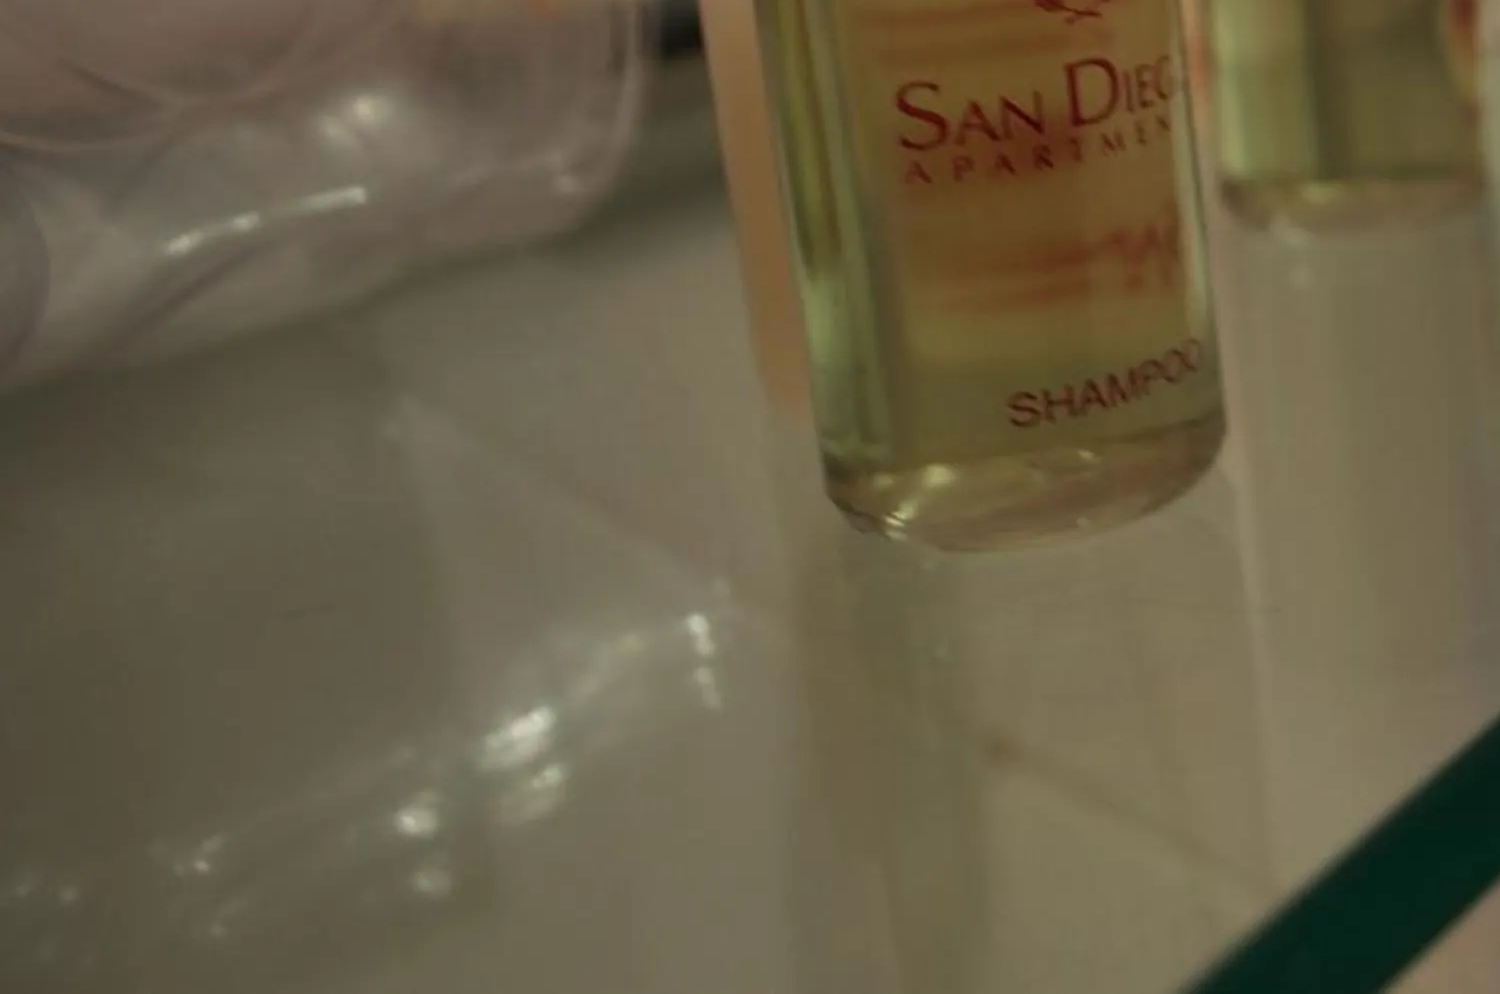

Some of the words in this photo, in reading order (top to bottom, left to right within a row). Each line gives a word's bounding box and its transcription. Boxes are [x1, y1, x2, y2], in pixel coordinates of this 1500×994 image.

[895, 80, 1046, 152] SAN
[1064, 54, 1180, 128] DIEG
[904, 113, 1174, 185] APARTMEN
[1007, 337, 1203, 428] SHAMPOO
